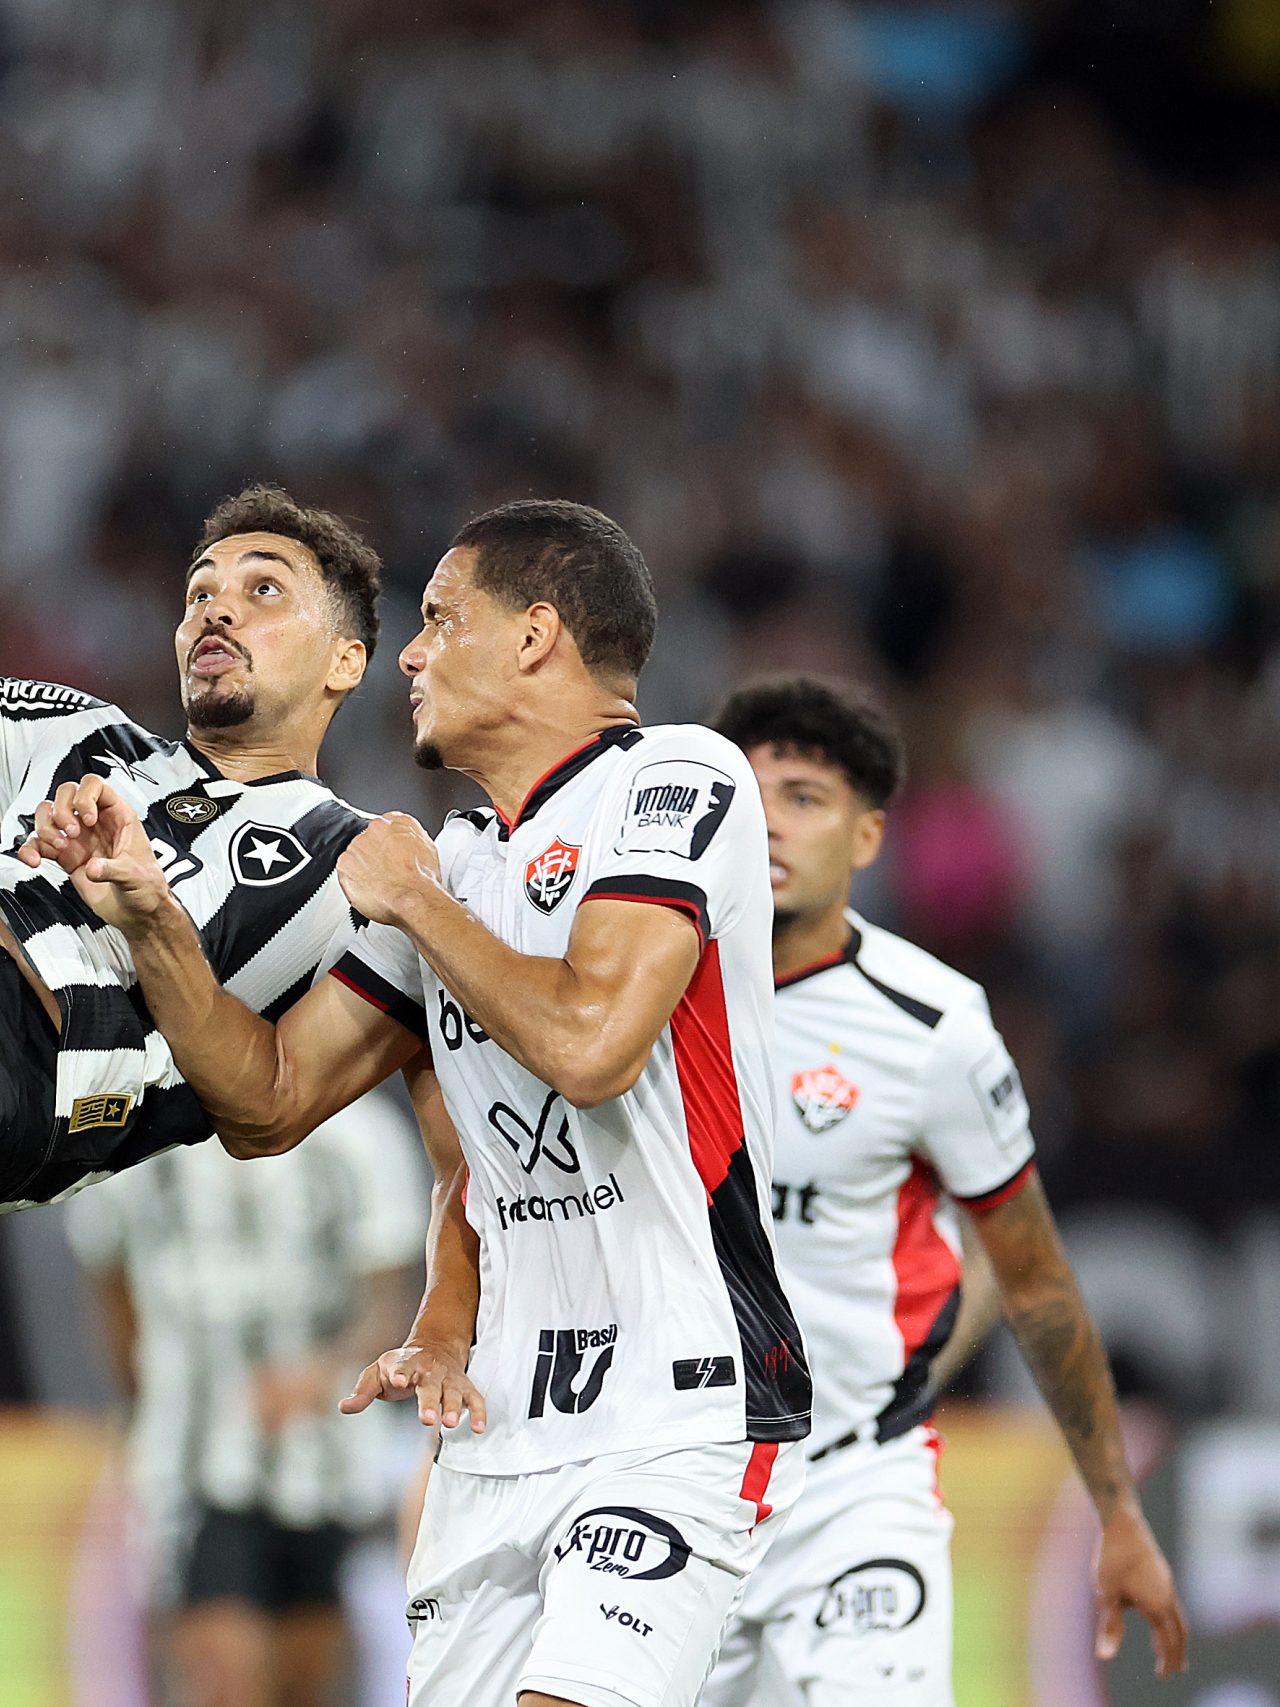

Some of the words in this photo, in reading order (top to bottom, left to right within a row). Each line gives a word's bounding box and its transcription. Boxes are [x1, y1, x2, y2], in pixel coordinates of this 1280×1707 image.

[634, 782, 699, 816] VITÓRIA
[638, 813, 689, 829] BANK
[577, 1323, 618, 1351] Brasil
[589, 1554, 631, 1577] Zero
